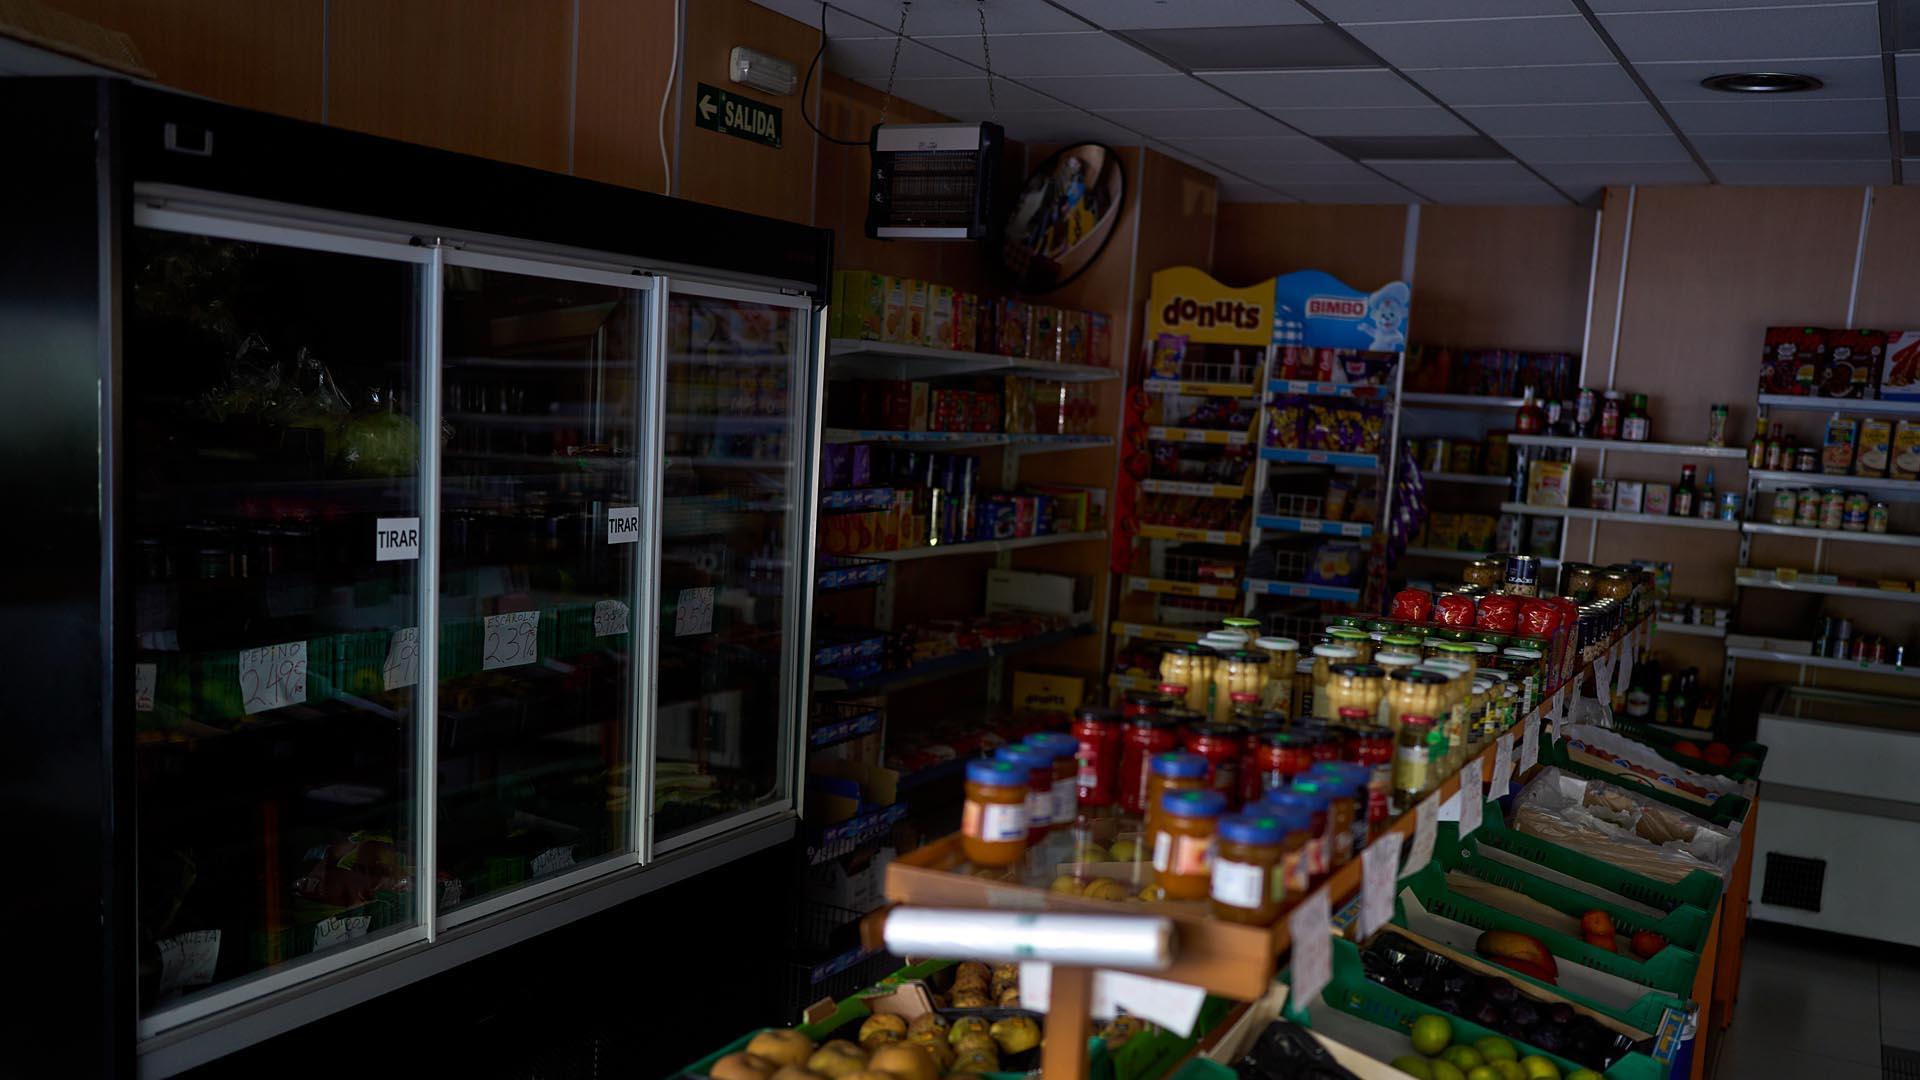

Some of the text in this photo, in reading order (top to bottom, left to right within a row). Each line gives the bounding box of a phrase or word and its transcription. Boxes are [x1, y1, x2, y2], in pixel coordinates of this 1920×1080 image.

[724, 101, 776, 139] SALIDA
[1163, 297, 1260, 328] donuts
[1308, 299, 1365, 316] BIMBO
[609, 516, 638, 534] TIRAR
[378, 529, 419, 549] TIRAR
